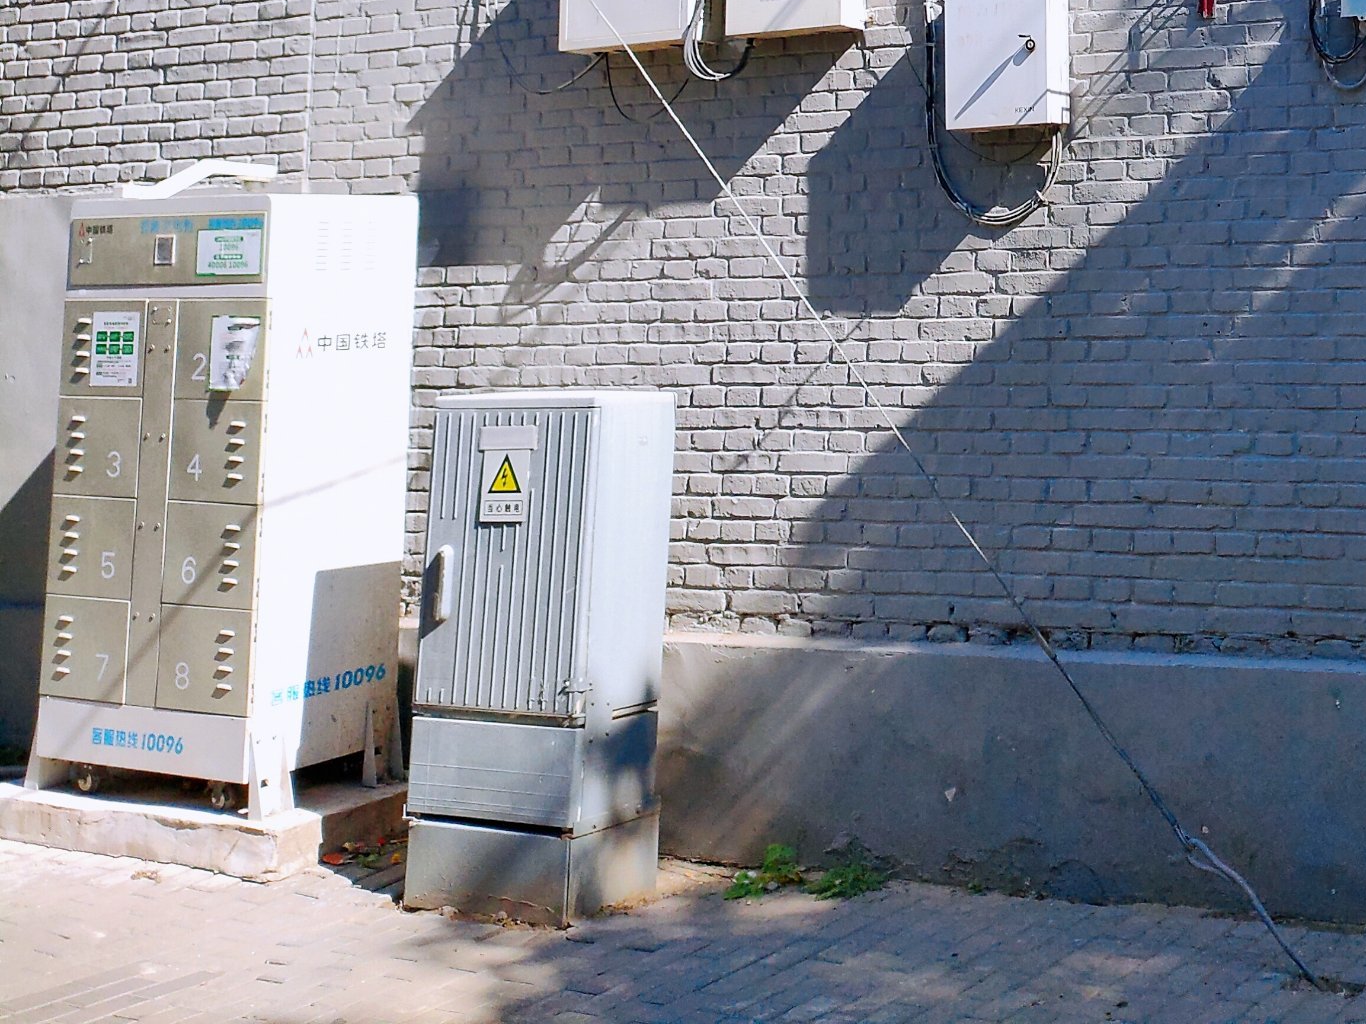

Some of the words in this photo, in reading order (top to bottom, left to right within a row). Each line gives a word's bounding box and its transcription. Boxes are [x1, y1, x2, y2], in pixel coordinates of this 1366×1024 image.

[317, 332, 387, 352] 中国铁塔
[190, 352, 207, 381] 2
[106, 450, 121, 478] 3
[186, 453, 202, 482] 4
[101, 551, 116, 579] 5
[181, 556, 197, 585] 6
[95, 653, 109, 681] 7
[175, 662, 190, 690] 8
